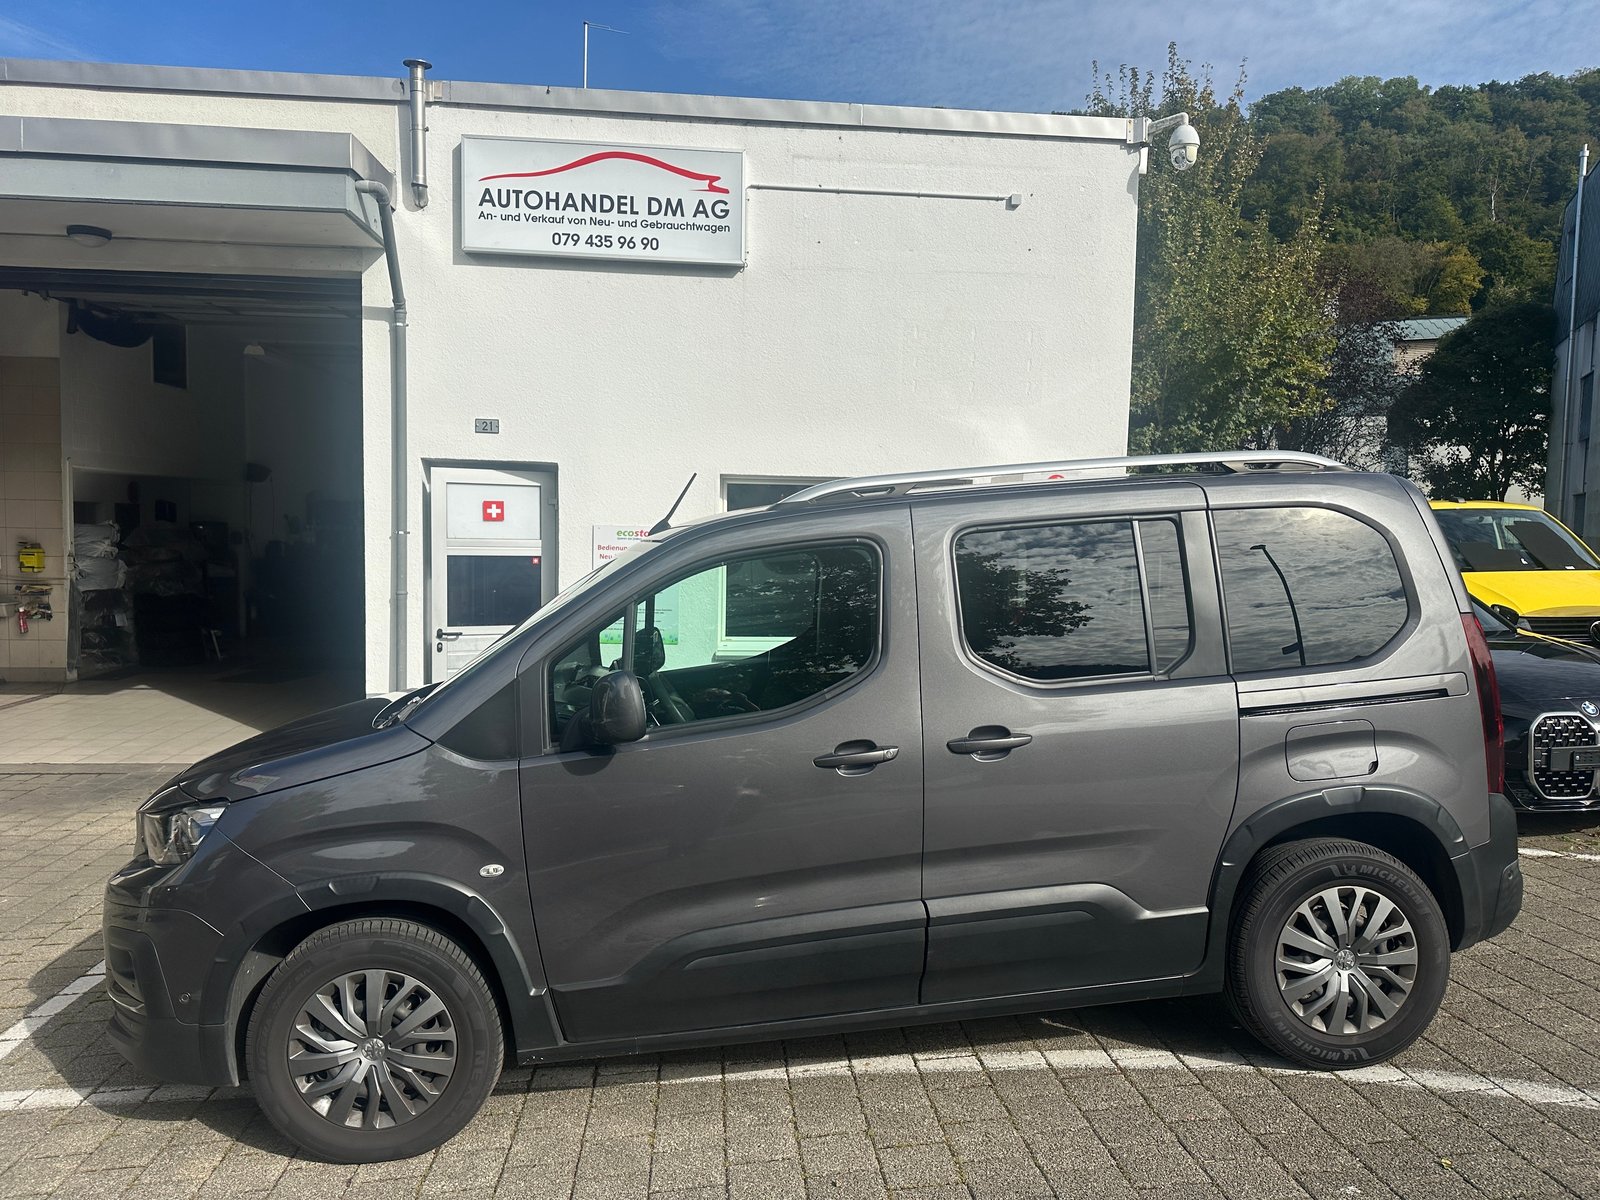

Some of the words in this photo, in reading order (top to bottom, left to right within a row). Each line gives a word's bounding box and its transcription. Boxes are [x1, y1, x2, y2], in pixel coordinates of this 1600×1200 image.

[478, 188, 639, 215] AUTOHANDEL
[647, 196, 685, 217] DM
[692, 199, 730, 219] AG
[478, 211, 498, 220] An-
[500, 213, 521, 222] und
[524, 213, 565, 224] Verkauf
[567, 217, 587, 225] von
[589, 217, 615, 226] Neu-
[618, 219, 638, 228] und
[640, 219, 730, 234] Gebrauchtwagen
[552, 232, 580, 246] 079
[585, 234, 613, 248] 435
[617, 236, 637, 249] 96
[641, 237, 660, 250] 90
[482, 421, 493, 431] 21
[1359, 863, 1425, 907] MICHELIN
[1273, 1018, 1340, 1061] MICHELIN
